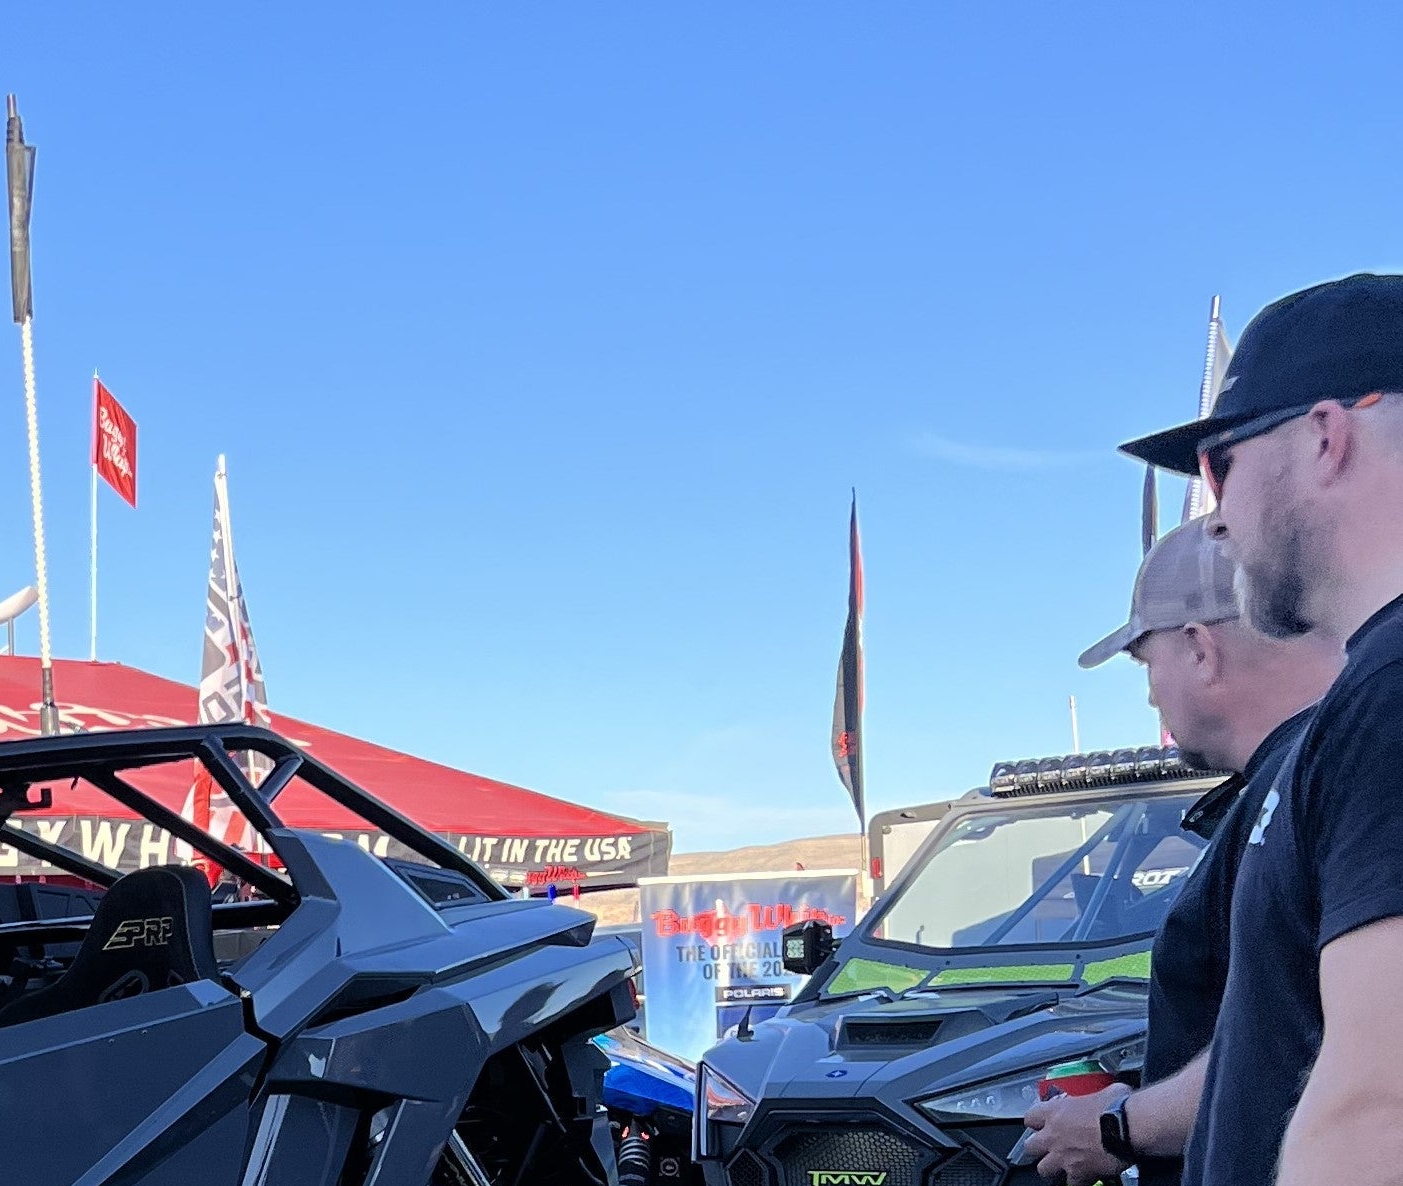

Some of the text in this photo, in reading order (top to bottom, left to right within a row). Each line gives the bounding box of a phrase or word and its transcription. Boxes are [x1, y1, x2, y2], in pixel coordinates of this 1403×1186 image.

[458, 836, 633, 863] LIT IN THE USA
[677, 945, 706, 963] THE
[703, 963, 723, 981] OF
[723, 987, 784, 1000] POLARIS
